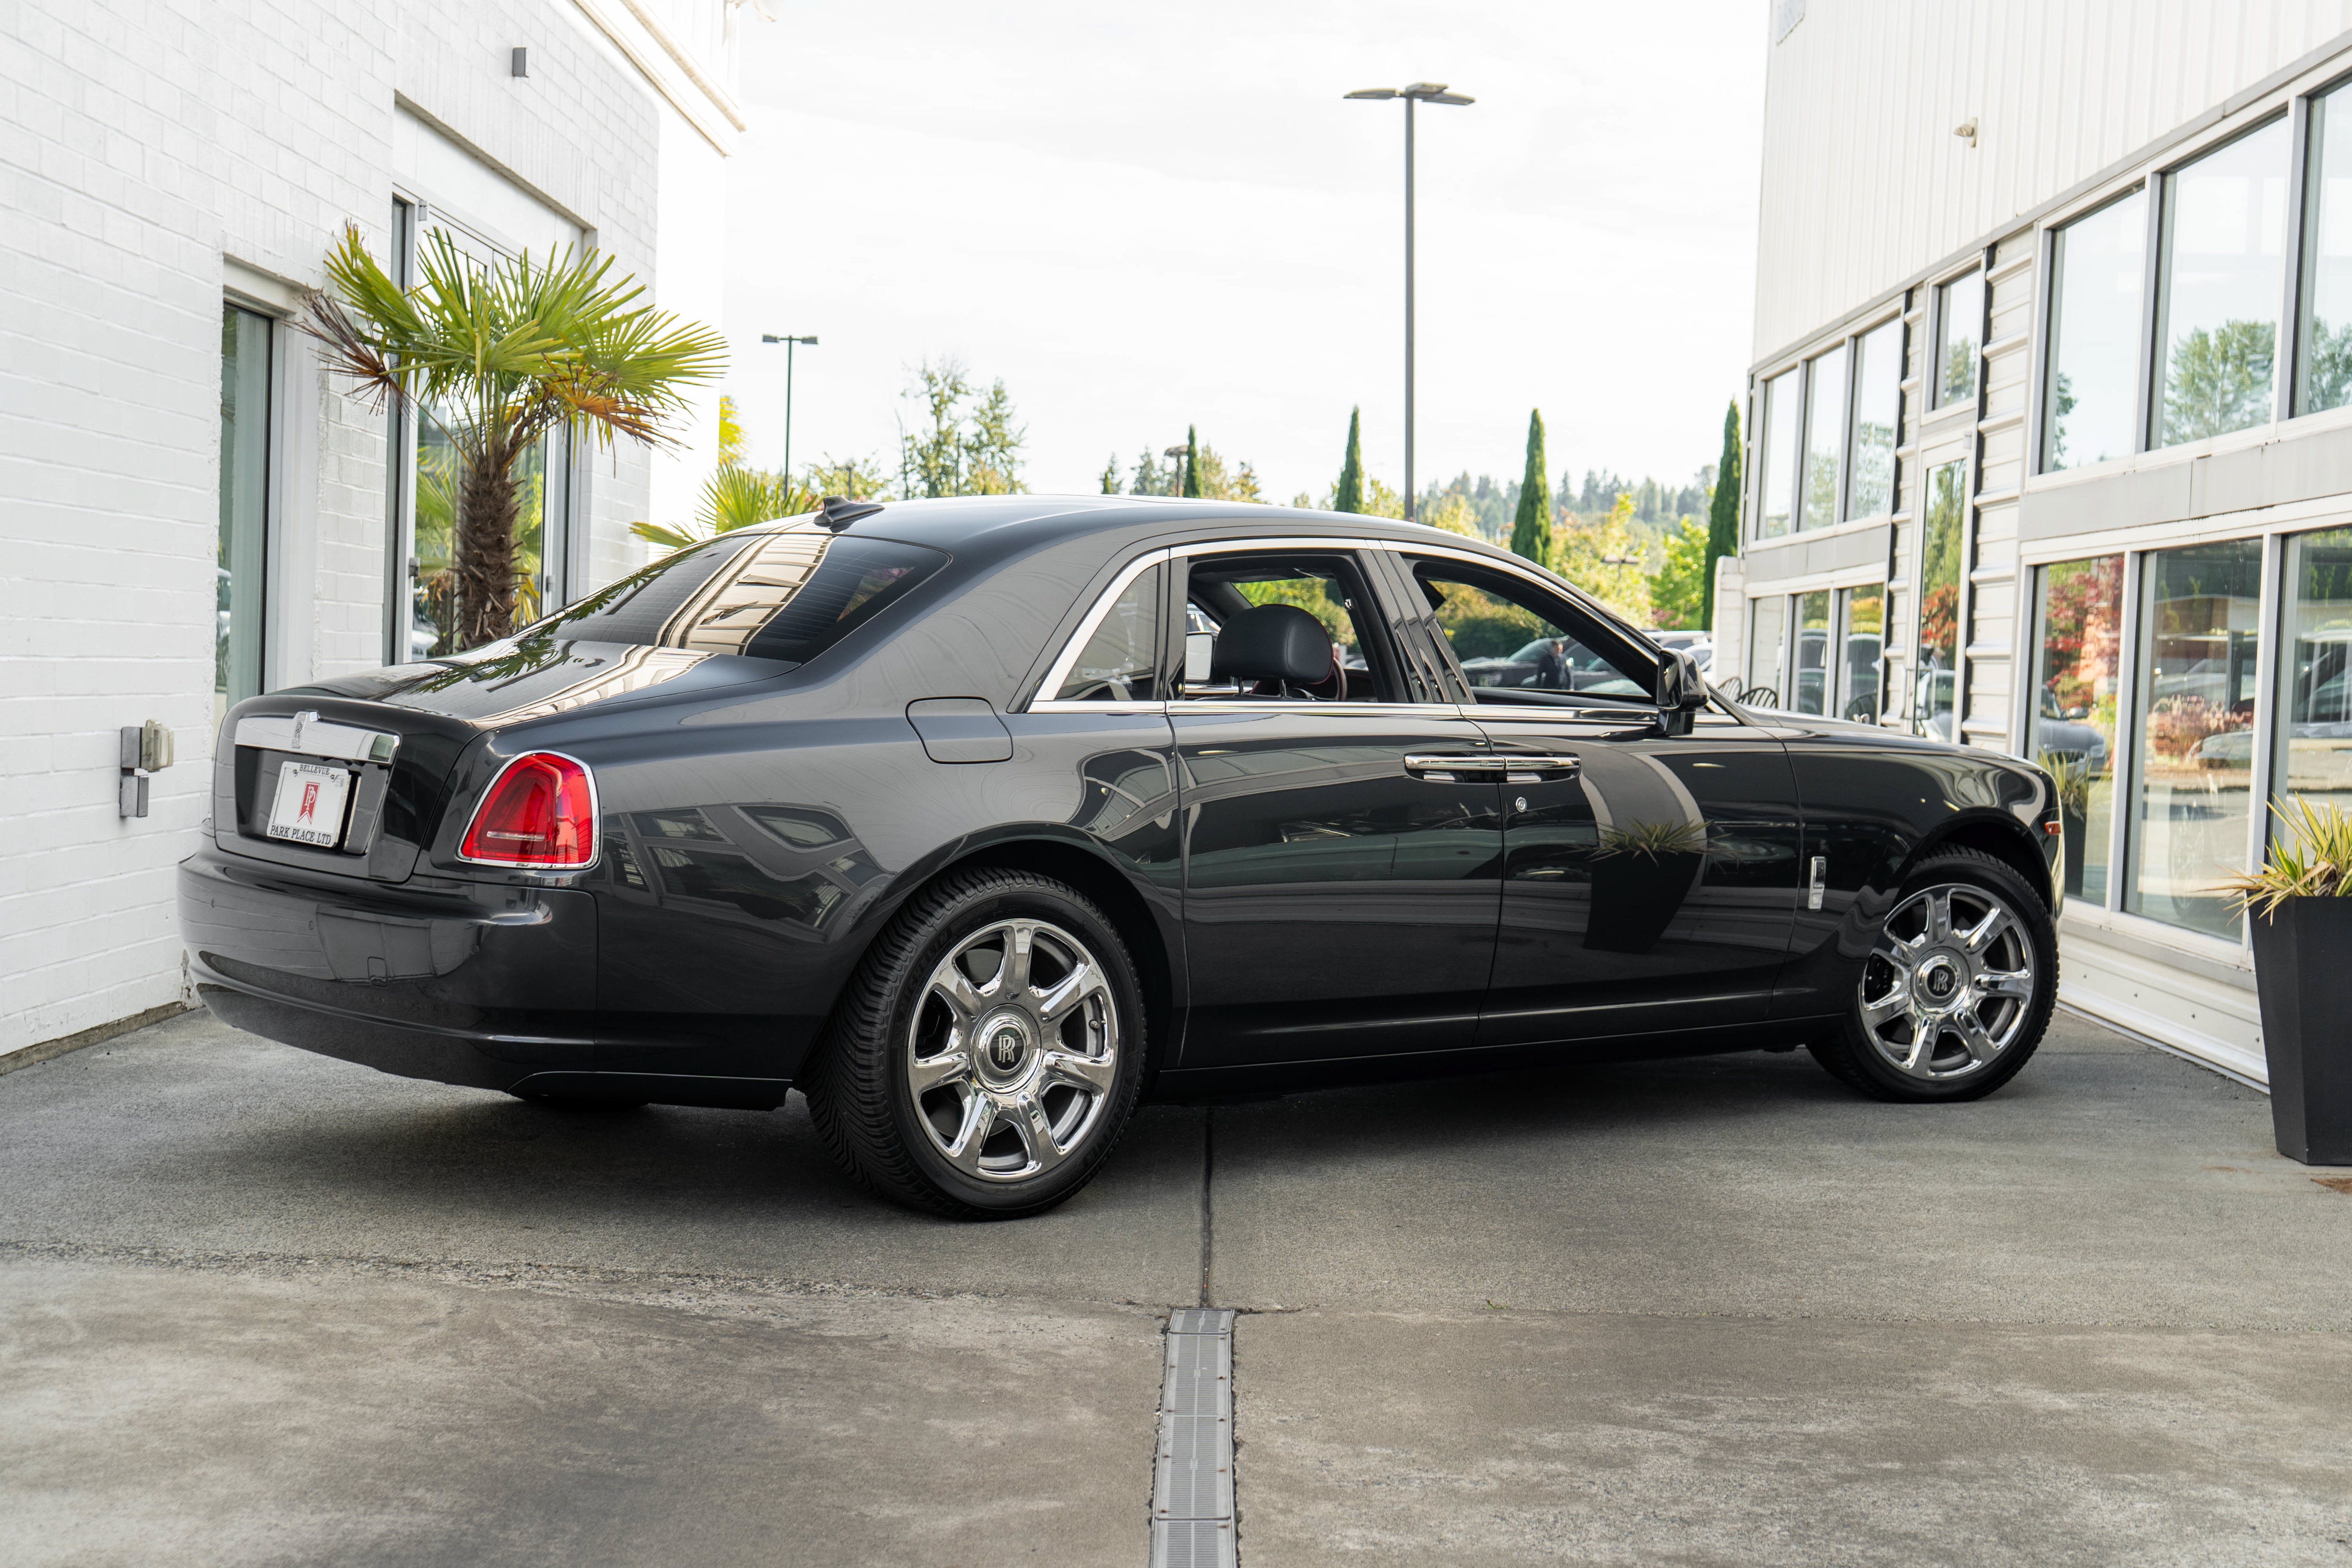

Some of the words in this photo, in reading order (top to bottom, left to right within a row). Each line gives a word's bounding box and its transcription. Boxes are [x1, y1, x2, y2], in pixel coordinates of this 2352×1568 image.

[299, 765, 330, 775] BELLEVUE
[270, 825, 290, 837] PARK
[291, 829, 315, 843] PLACE
[316, 833, 331, 845] LTD
[1933, 969, 1949, 991] RR
[998, 1035, 1016, 1063] RR
